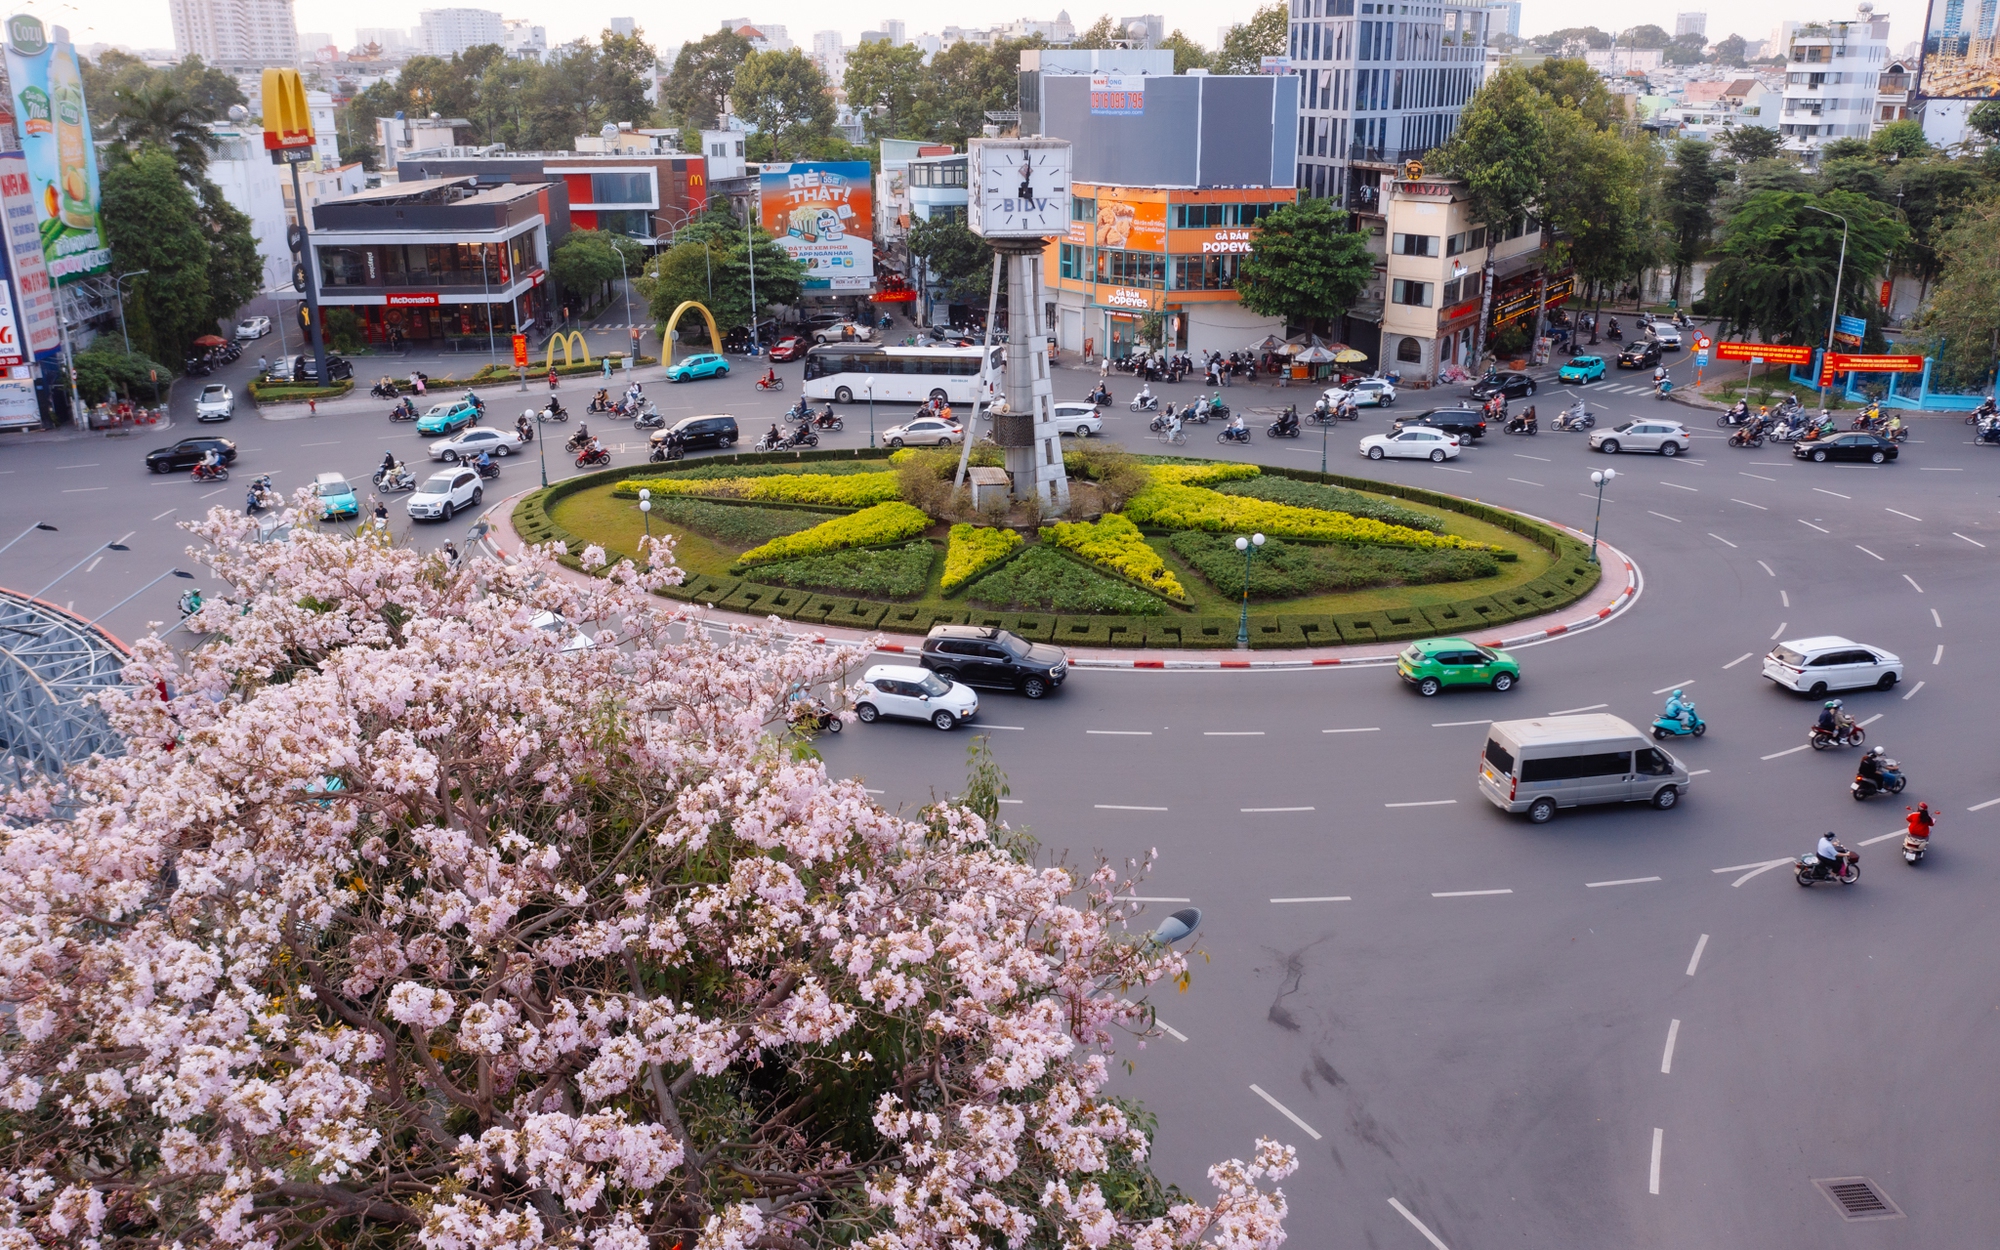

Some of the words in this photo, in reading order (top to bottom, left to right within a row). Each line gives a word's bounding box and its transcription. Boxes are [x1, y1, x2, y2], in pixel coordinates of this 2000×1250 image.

[13, 21, 43, 47] Cozy
[1091, 92, 1109, 109] 0916
[1110, 92, 1126, 109] 095
[1127, 92, 1144, 109] 795
[60, 104, 79, 123] Cozy
[1004, 199, 1048, 213] BIDV
[1215, 230, 1228, 241] GÀ
[1229, 229, 1249, 241] RÁN
[366, 251, 376, 279] playplace
[390, 296, 435, 304] McDonald's
[1115, 287, 1125, 297] GÀ
[1125, 288, 1140, 298] RÁN
